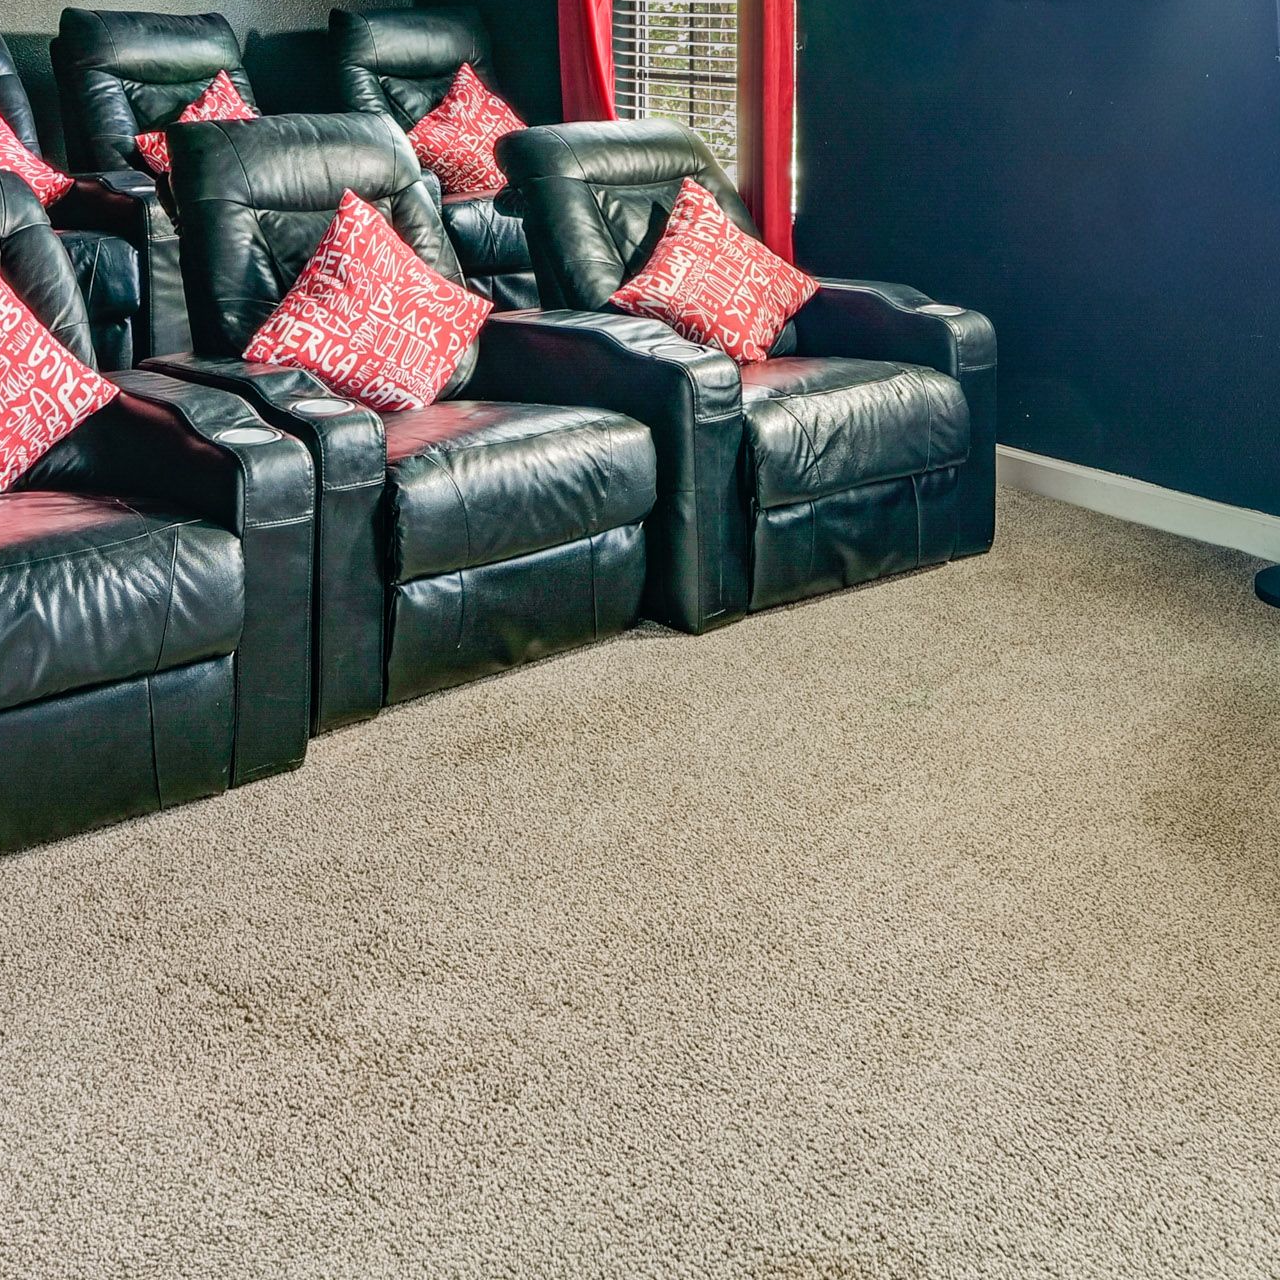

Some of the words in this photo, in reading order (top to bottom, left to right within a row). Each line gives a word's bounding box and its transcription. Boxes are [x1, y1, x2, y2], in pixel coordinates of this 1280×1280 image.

[368, 283, 442, 348] BLACK
[398, 286, 469, 330] Marvel
[724, 261, 771, 325] BLACK
